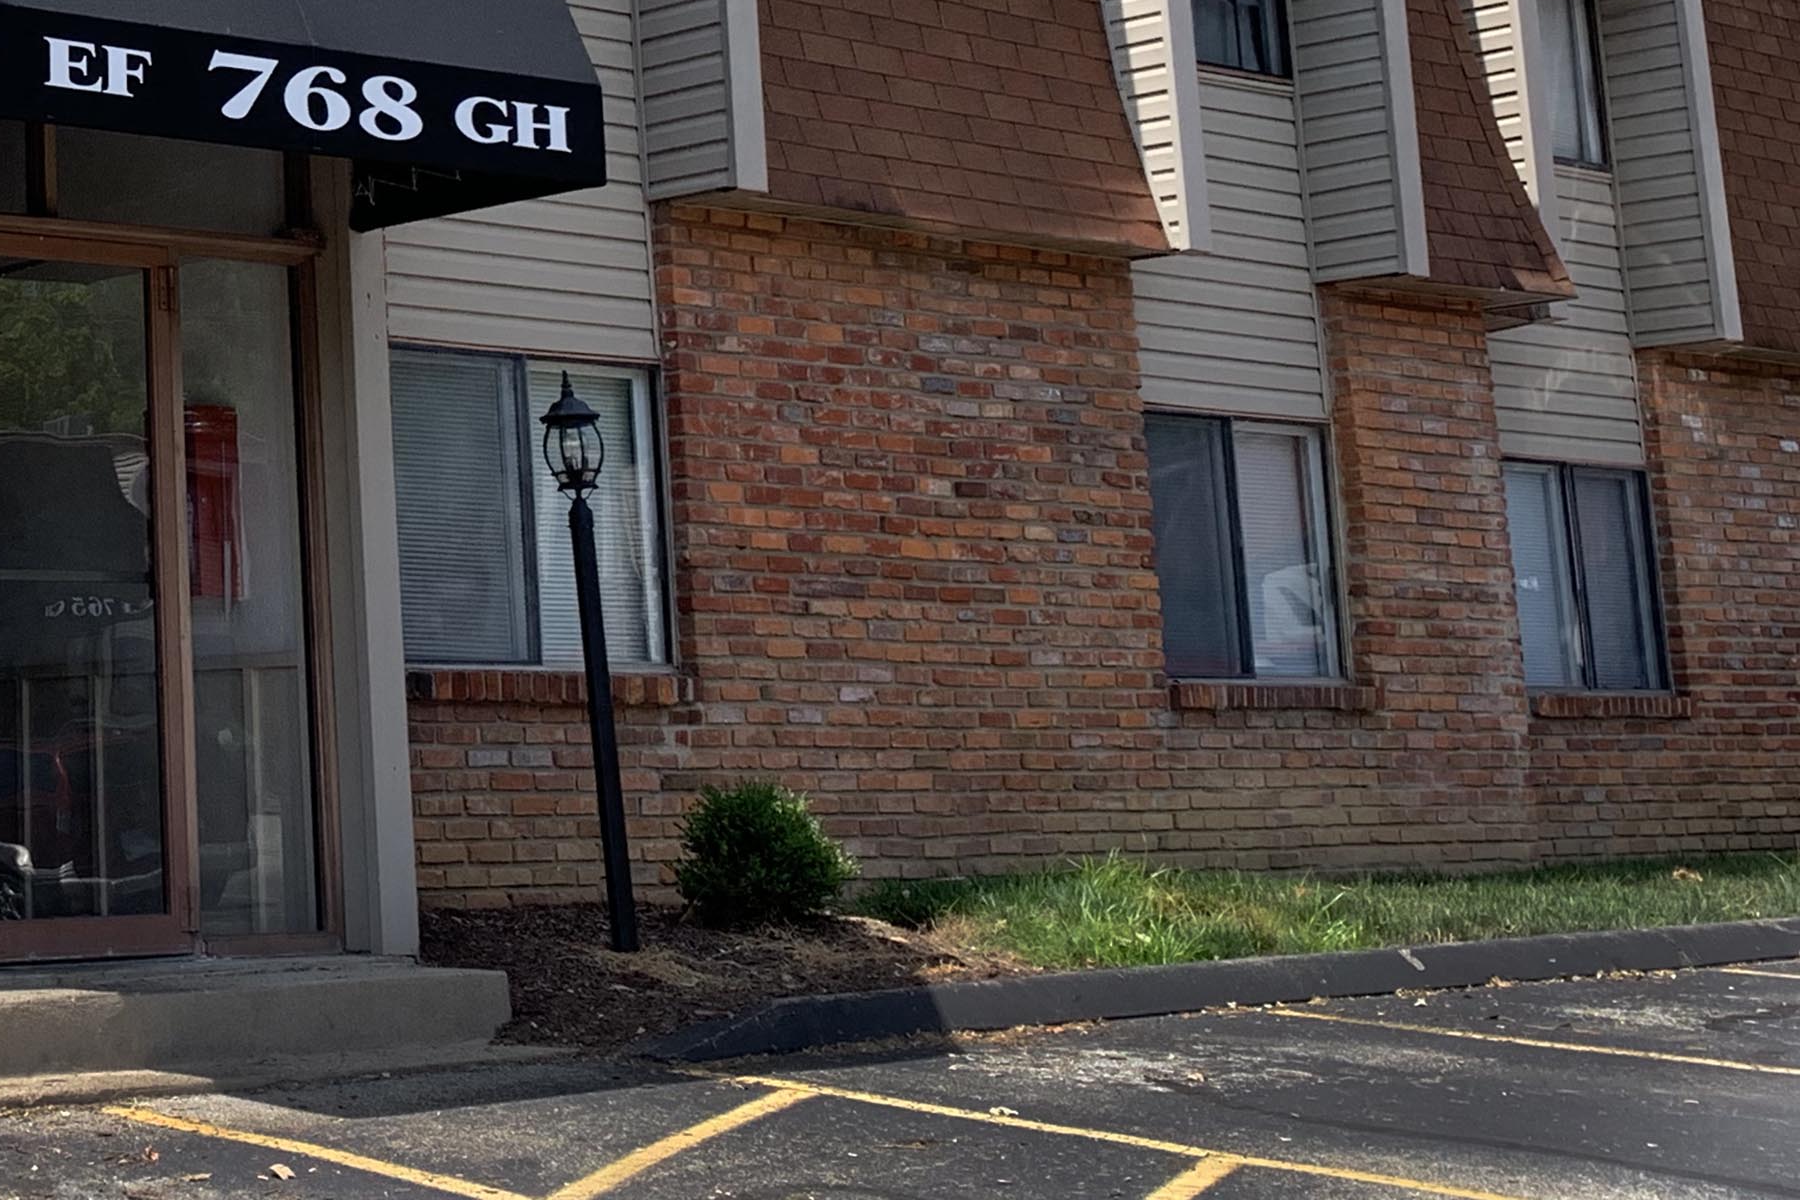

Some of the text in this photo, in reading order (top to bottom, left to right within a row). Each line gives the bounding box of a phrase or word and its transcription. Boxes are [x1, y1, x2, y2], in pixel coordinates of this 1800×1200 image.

[43, 36, 573, 153] EF 768 GH
